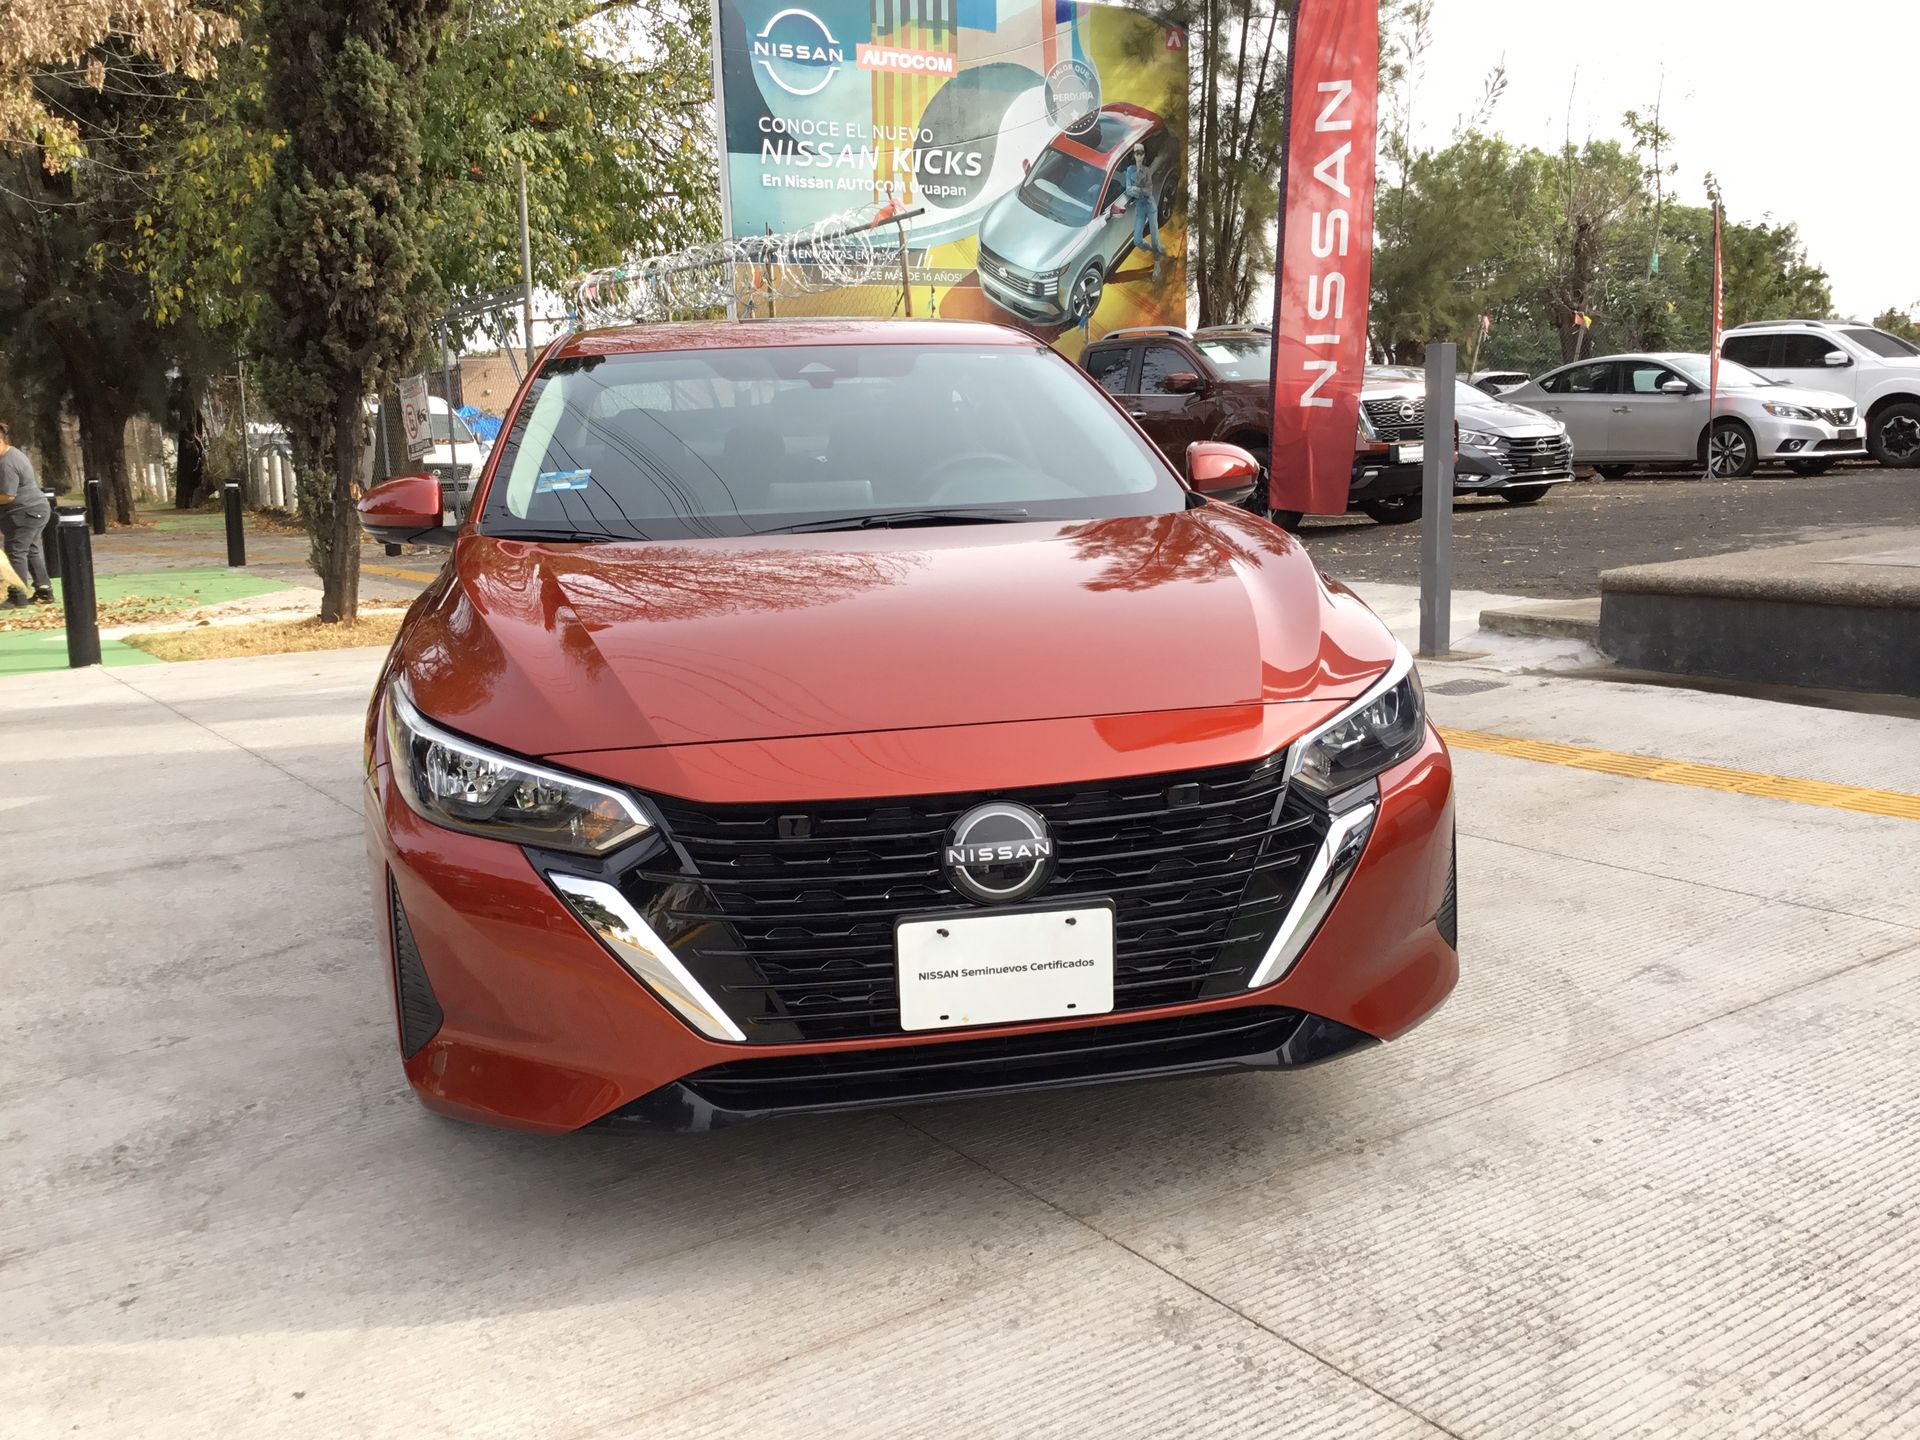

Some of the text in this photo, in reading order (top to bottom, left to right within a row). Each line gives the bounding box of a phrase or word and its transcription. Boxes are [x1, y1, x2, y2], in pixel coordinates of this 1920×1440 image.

[754, 41, 843, 63] NISSAN
[862, 50, 953, 73] AUTOCOM
[1052, 64, 1073, 80] VALOR
[1053, 91, 1094, 103] PERDURA
[758, 116, 934, 143] CONOCE EL NUEVO
[760, 138, 982, 177] NISSAN KICKS
[762, 173, 967, 198] En Nissan AUTOCOM Uruapan
[1300, 79, 1352, 408] NISSAN
[923, 272, 932, 281] 16
[934, 271, 963, 282] AÑOS!
[949, 841, 1050, 863] NISSAN
[918, 958, 1095, 981] NISSAN Seminuevos Certificados
